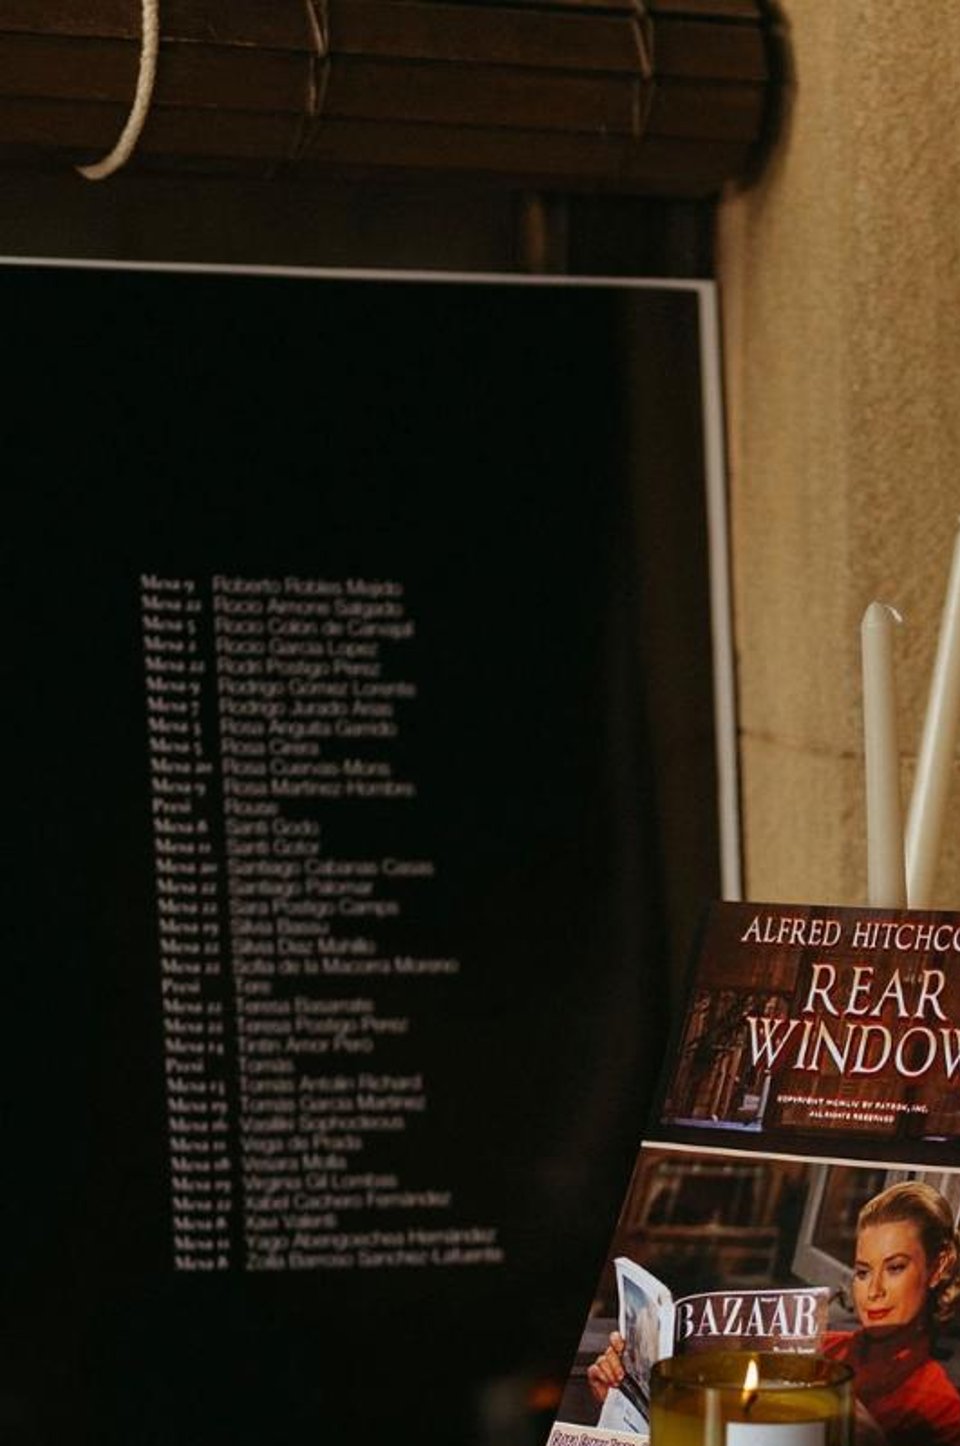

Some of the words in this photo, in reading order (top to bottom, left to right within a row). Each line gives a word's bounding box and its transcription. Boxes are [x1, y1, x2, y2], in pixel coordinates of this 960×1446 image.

[740, 916, 841, 947] ALFRED
[803, 963, 948, 1021] REAR
[679, 1295, 818, 1339] BAZAAR
